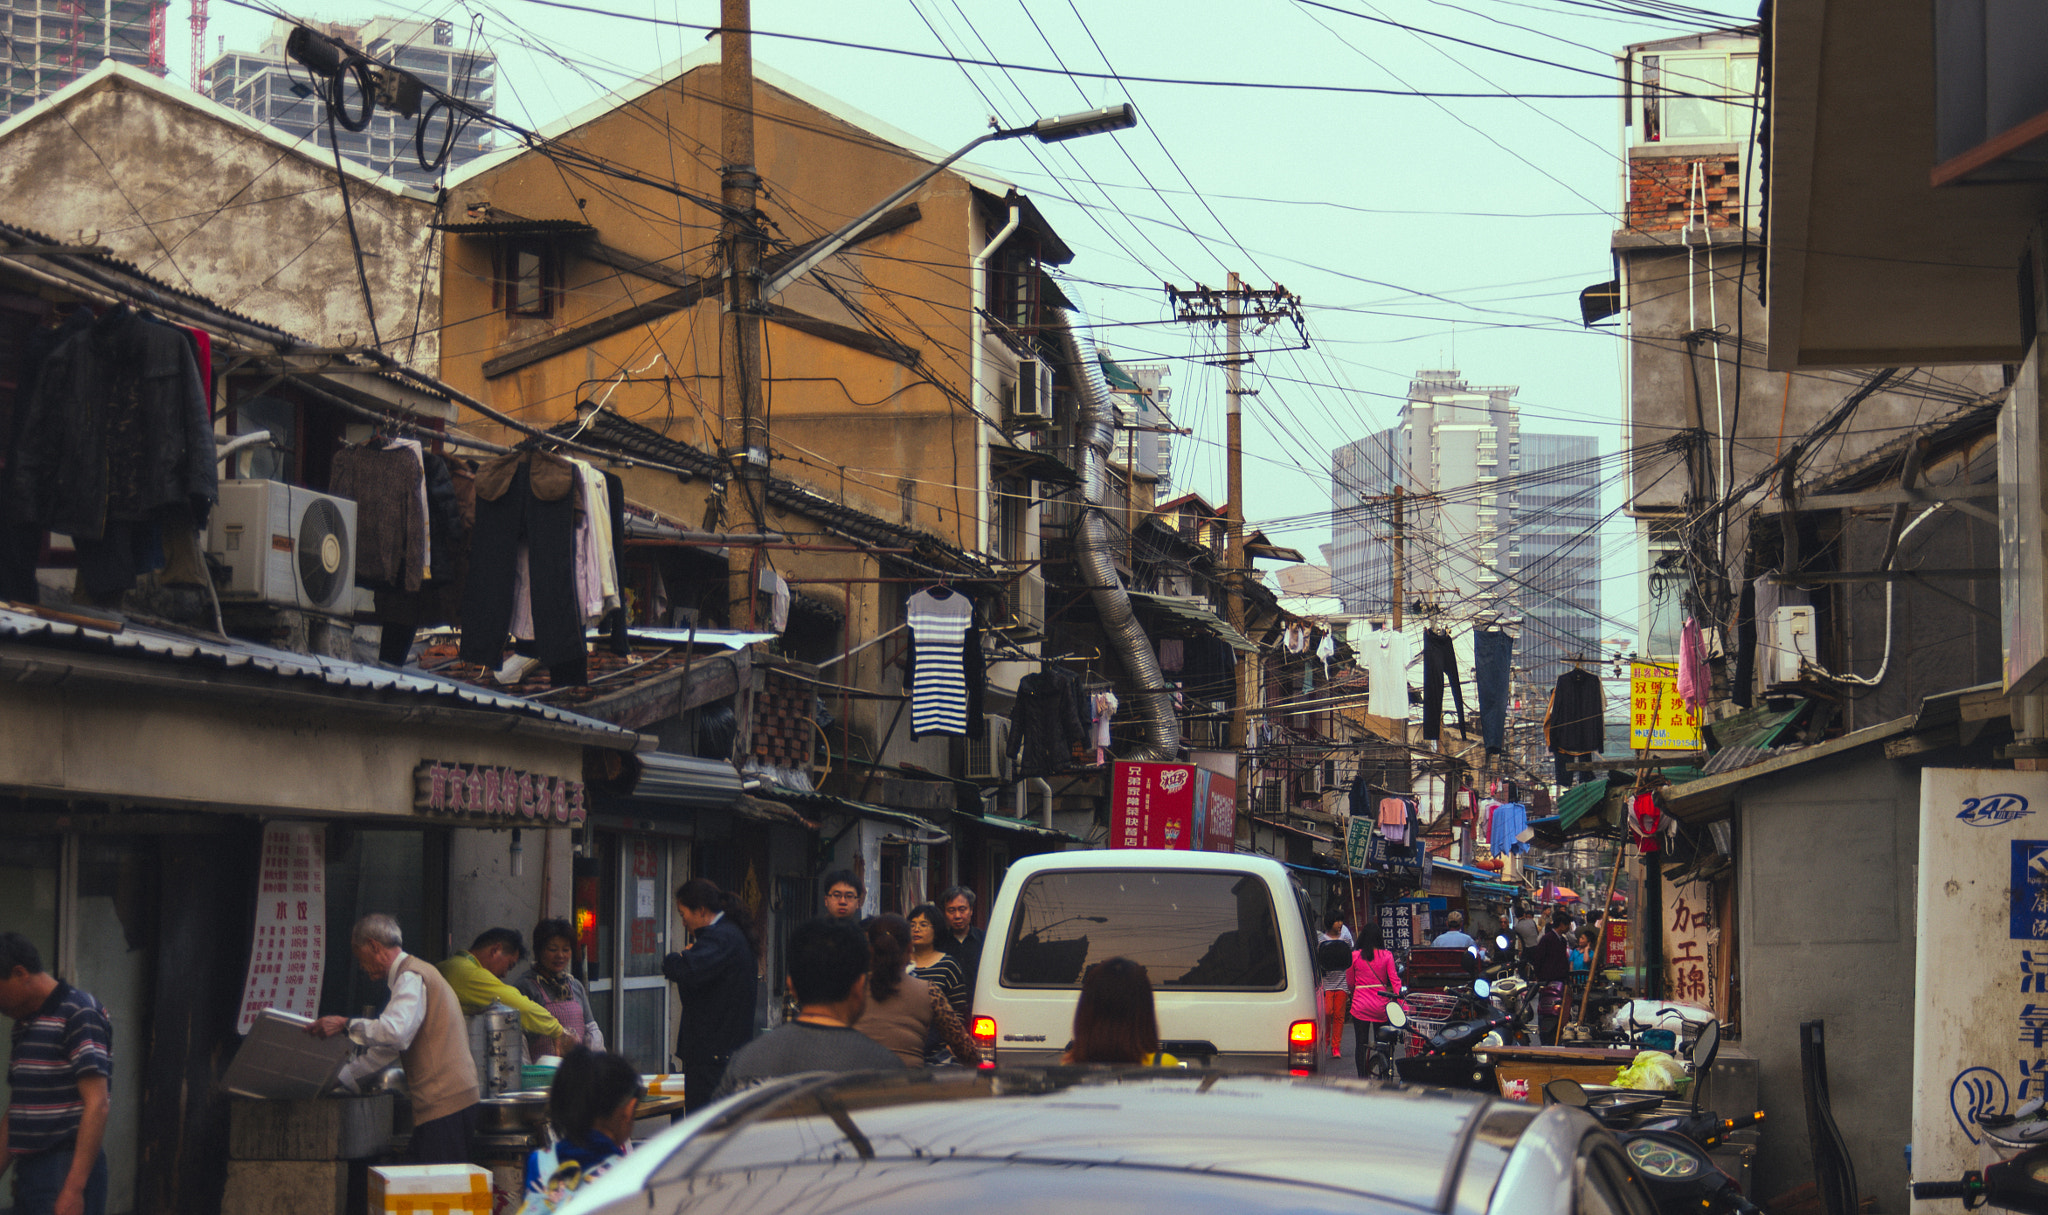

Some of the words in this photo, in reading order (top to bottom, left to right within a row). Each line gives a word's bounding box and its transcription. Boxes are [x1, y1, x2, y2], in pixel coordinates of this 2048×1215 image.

[1635, 682, 1661, 694] 汉堡
[1635, 698, 1661, 710] 奶昔
[1635, 714, 1662, 726] 果汁
[1671, 714, 1697, 726] 点心
[430, 760, 587, 822] 南京金陵特色汤包王
[1124, 766, 1142, 847] 兄弟家常菜快餐店
[1353, 826, 1370, 868] 五金建材
[276, 901, 308, 921] 水饺
[1671, 898, 1708, 1001] 加工棉
